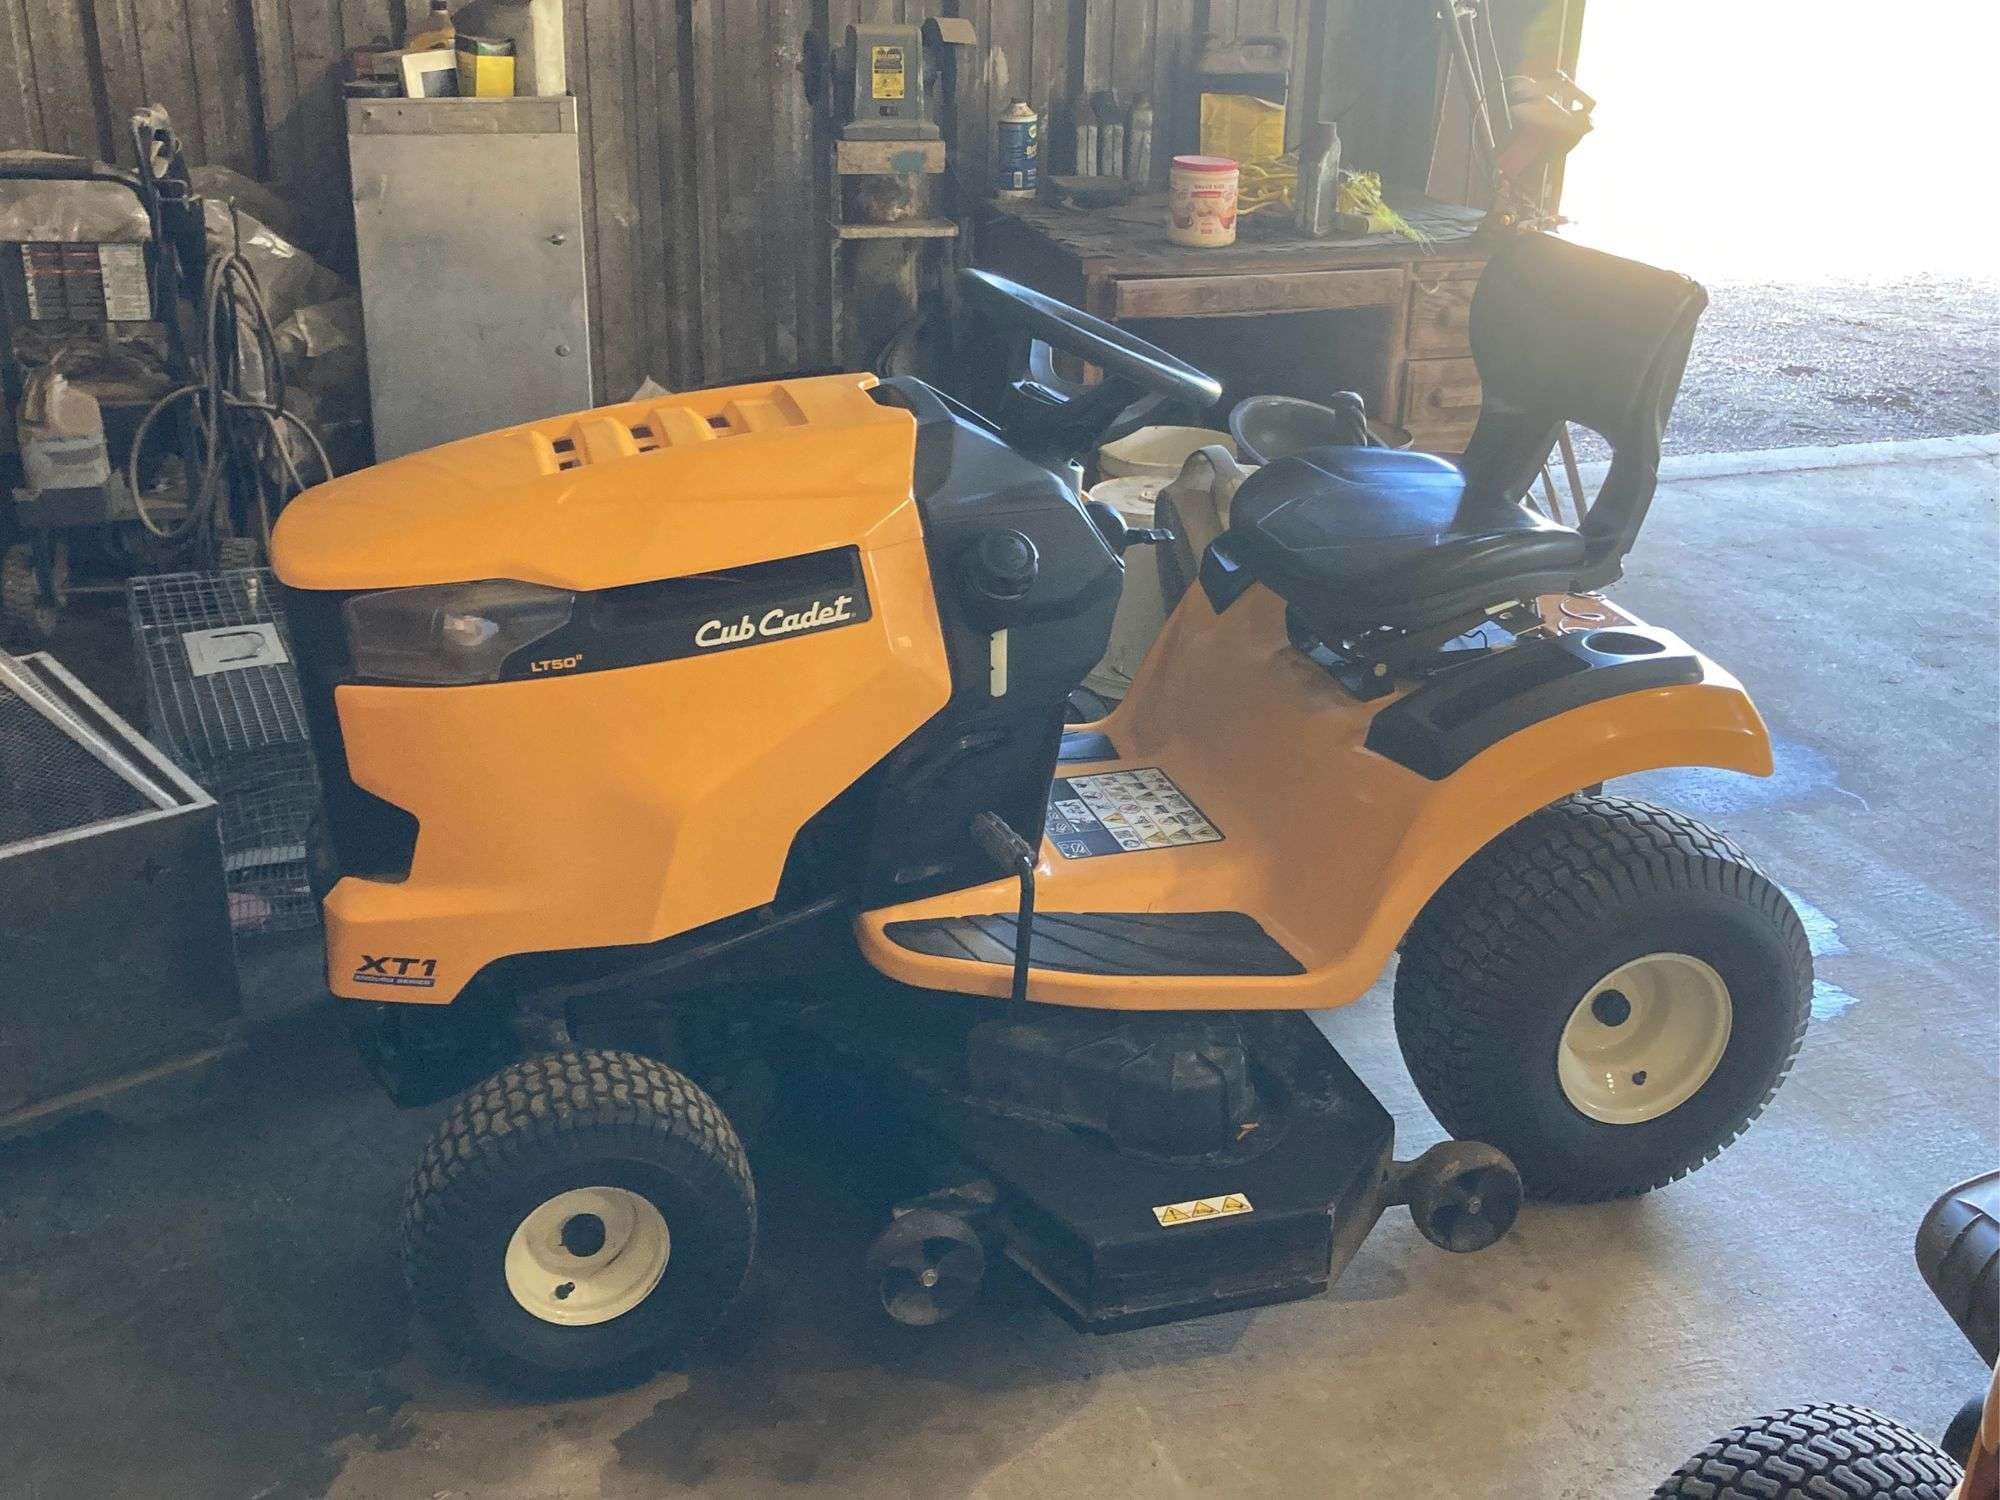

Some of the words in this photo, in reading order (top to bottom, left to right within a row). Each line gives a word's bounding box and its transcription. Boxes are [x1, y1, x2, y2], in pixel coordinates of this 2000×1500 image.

[695, 615, 756, 647] Cub
[759, 595, 853, 637] Cadet
[355, 954, 437, 976] XT1
